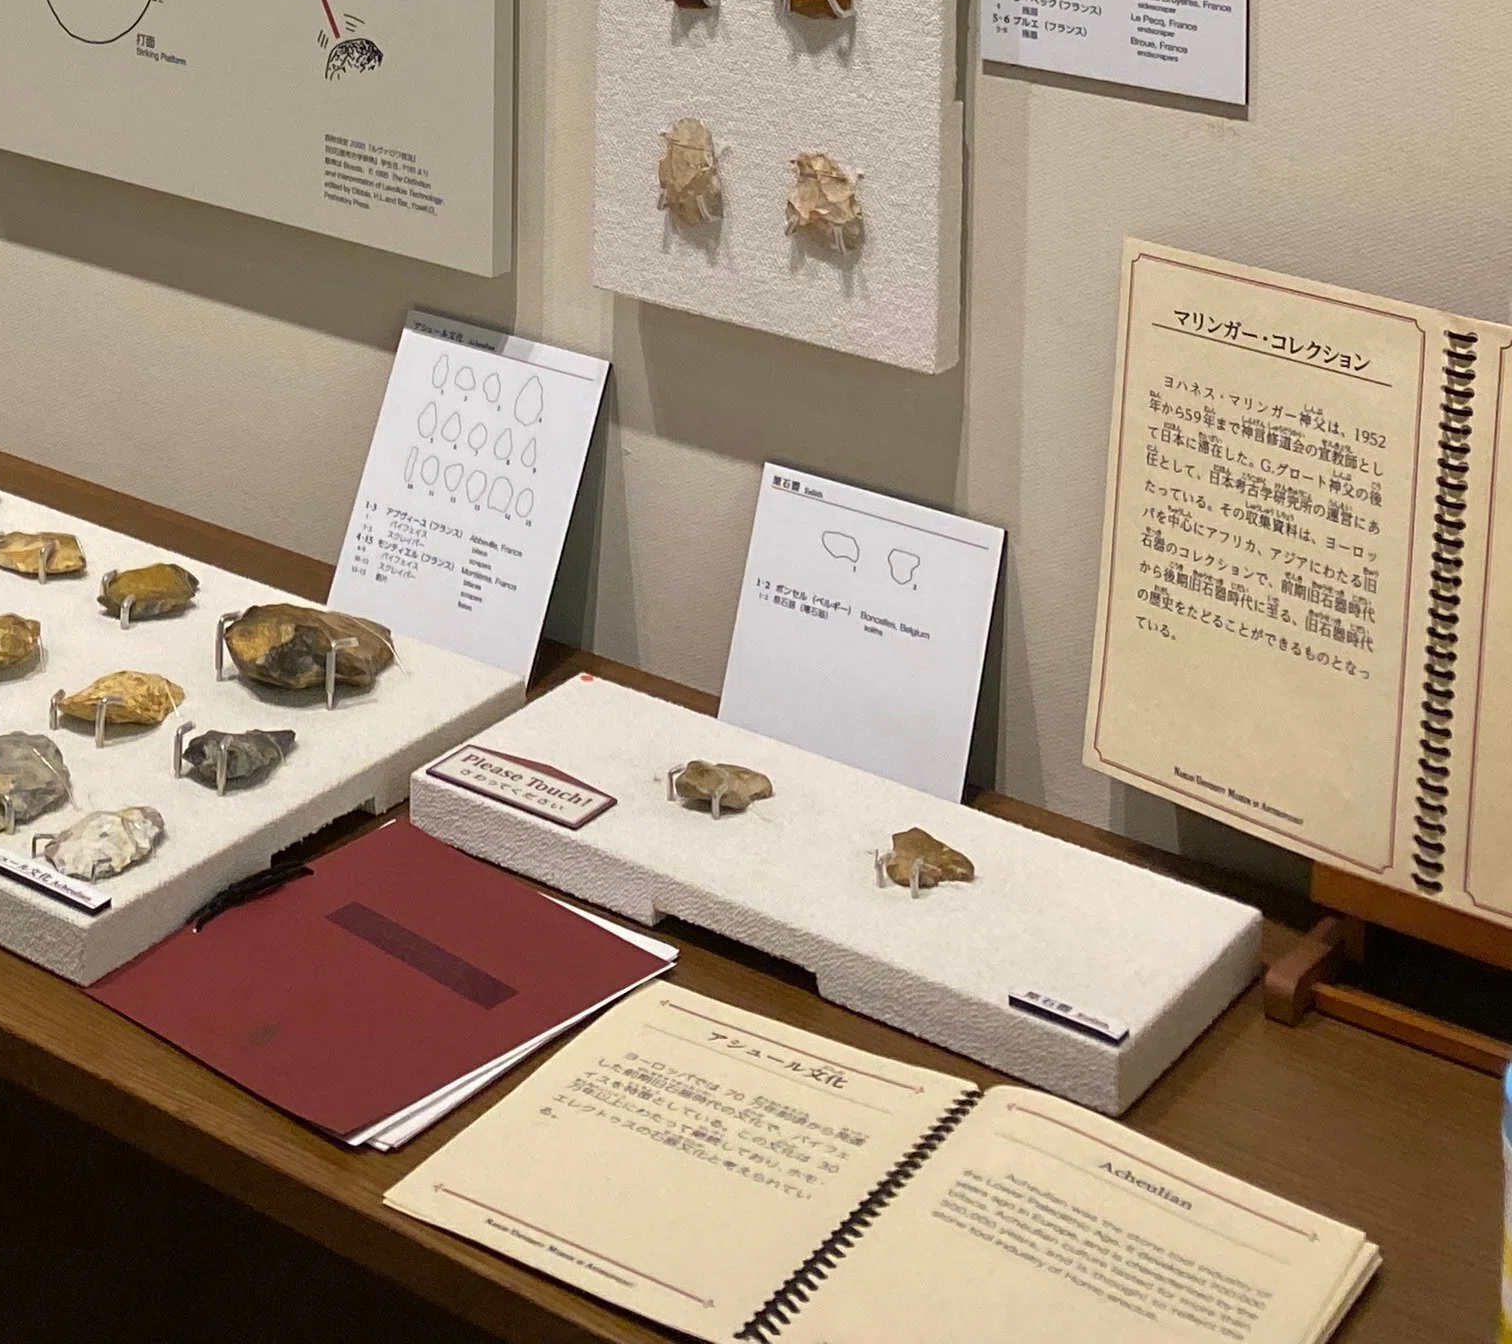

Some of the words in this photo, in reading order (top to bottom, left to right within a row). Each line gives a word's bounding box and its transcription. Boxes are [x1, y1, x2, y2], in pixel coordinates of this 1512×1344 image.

[1131, 13, 1141, 21] Le
[1169, 19, 1197, 31] France
[1203, 0, 1232, 12] France
[1160, 41, 1188, 54] France
[1173, 309, 1371, 372] マリンガー・コレクション
[900, 623, 930, 639] Belgium
[1135, 615, 1177, 641] ている。
[460, 769, 563, 810] さわってください
[461, 753, 523, 783] Please
[526, 777, 593, 808] Touch!
[707, 1032, 848, 1089] アシュール文化
[1099, 1162, 1192, 1211] Acheulian
